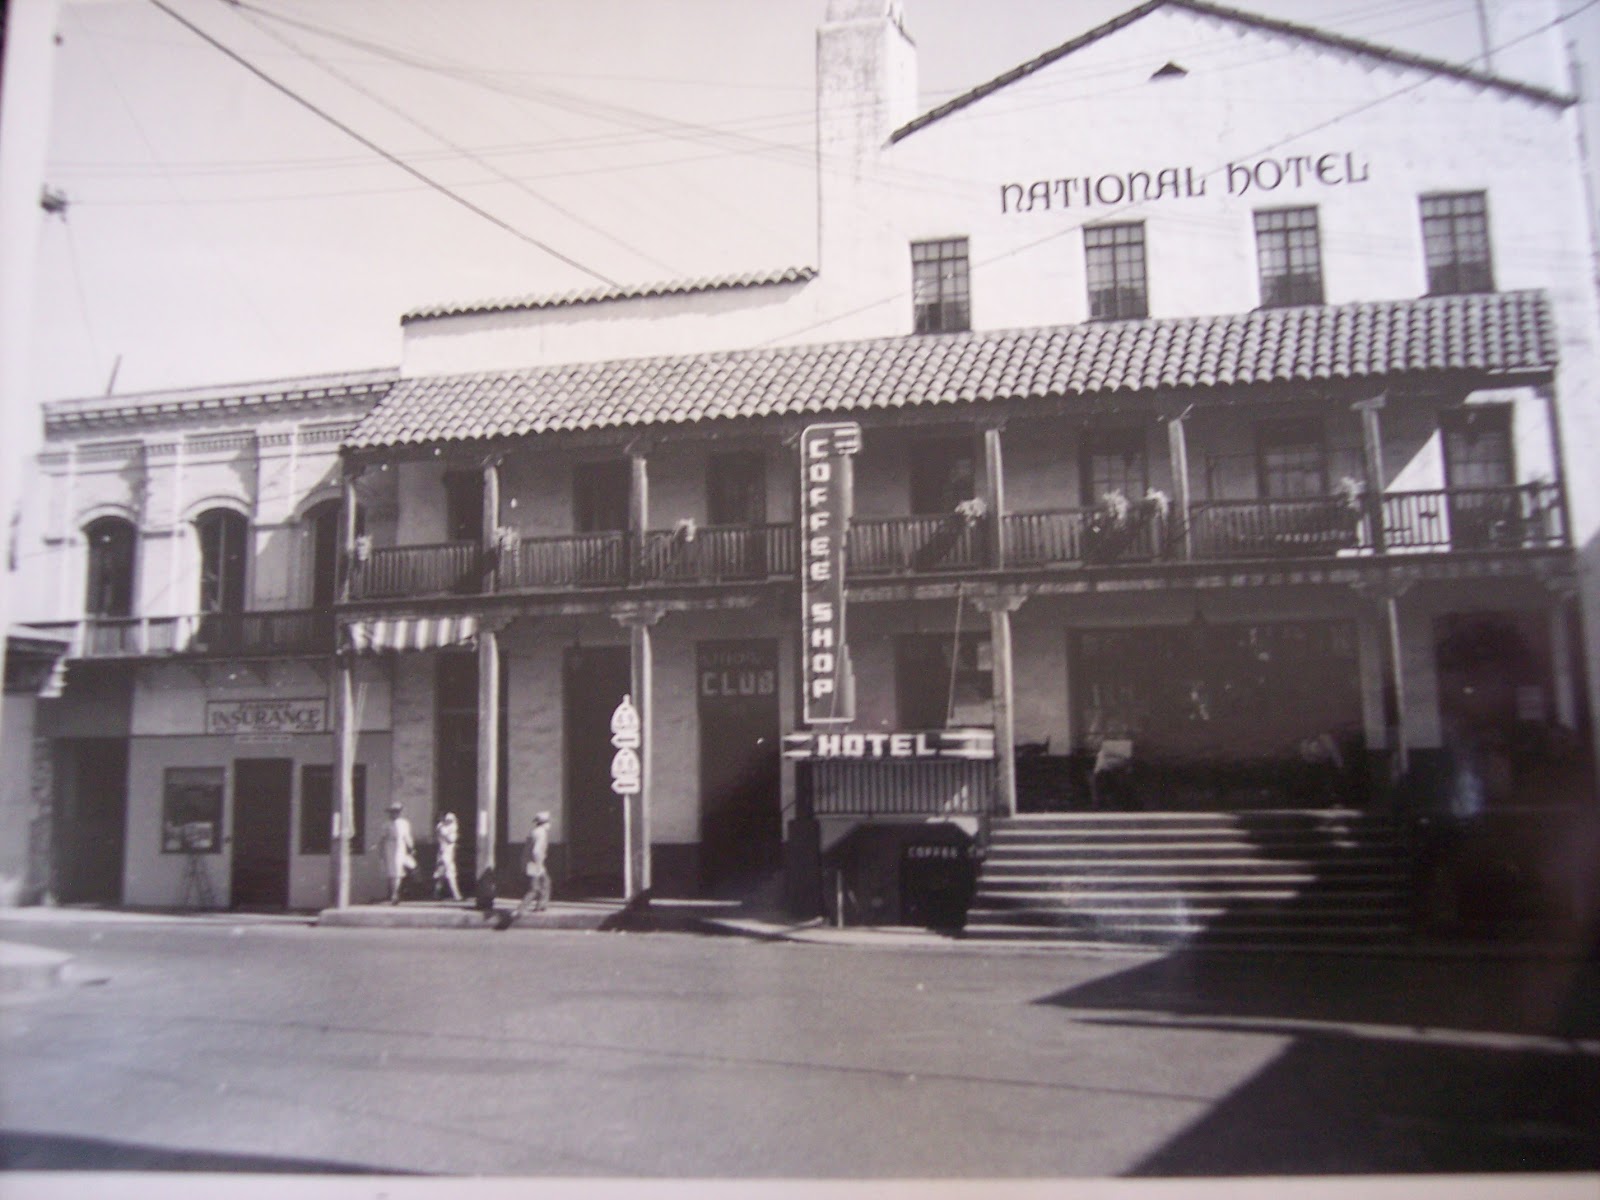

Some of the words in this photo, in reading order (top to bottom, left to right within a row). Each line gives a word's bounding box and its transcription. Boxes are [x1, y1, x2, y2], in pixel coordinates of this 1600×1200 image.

[1001, 167, 1206, 214] NATIONAL
[1225, 151, 1370, 197] HOTEL
[808, 438, 831, 582] COFFEE
[811, 602, 834, 699] SHOP
[702, 670, 774, 696] CLUB
[212, 708, 321, 725] INSURANCE
[818, 732, 937, 758] HOTEL
[908, 846, 958, 859] COFFEE
